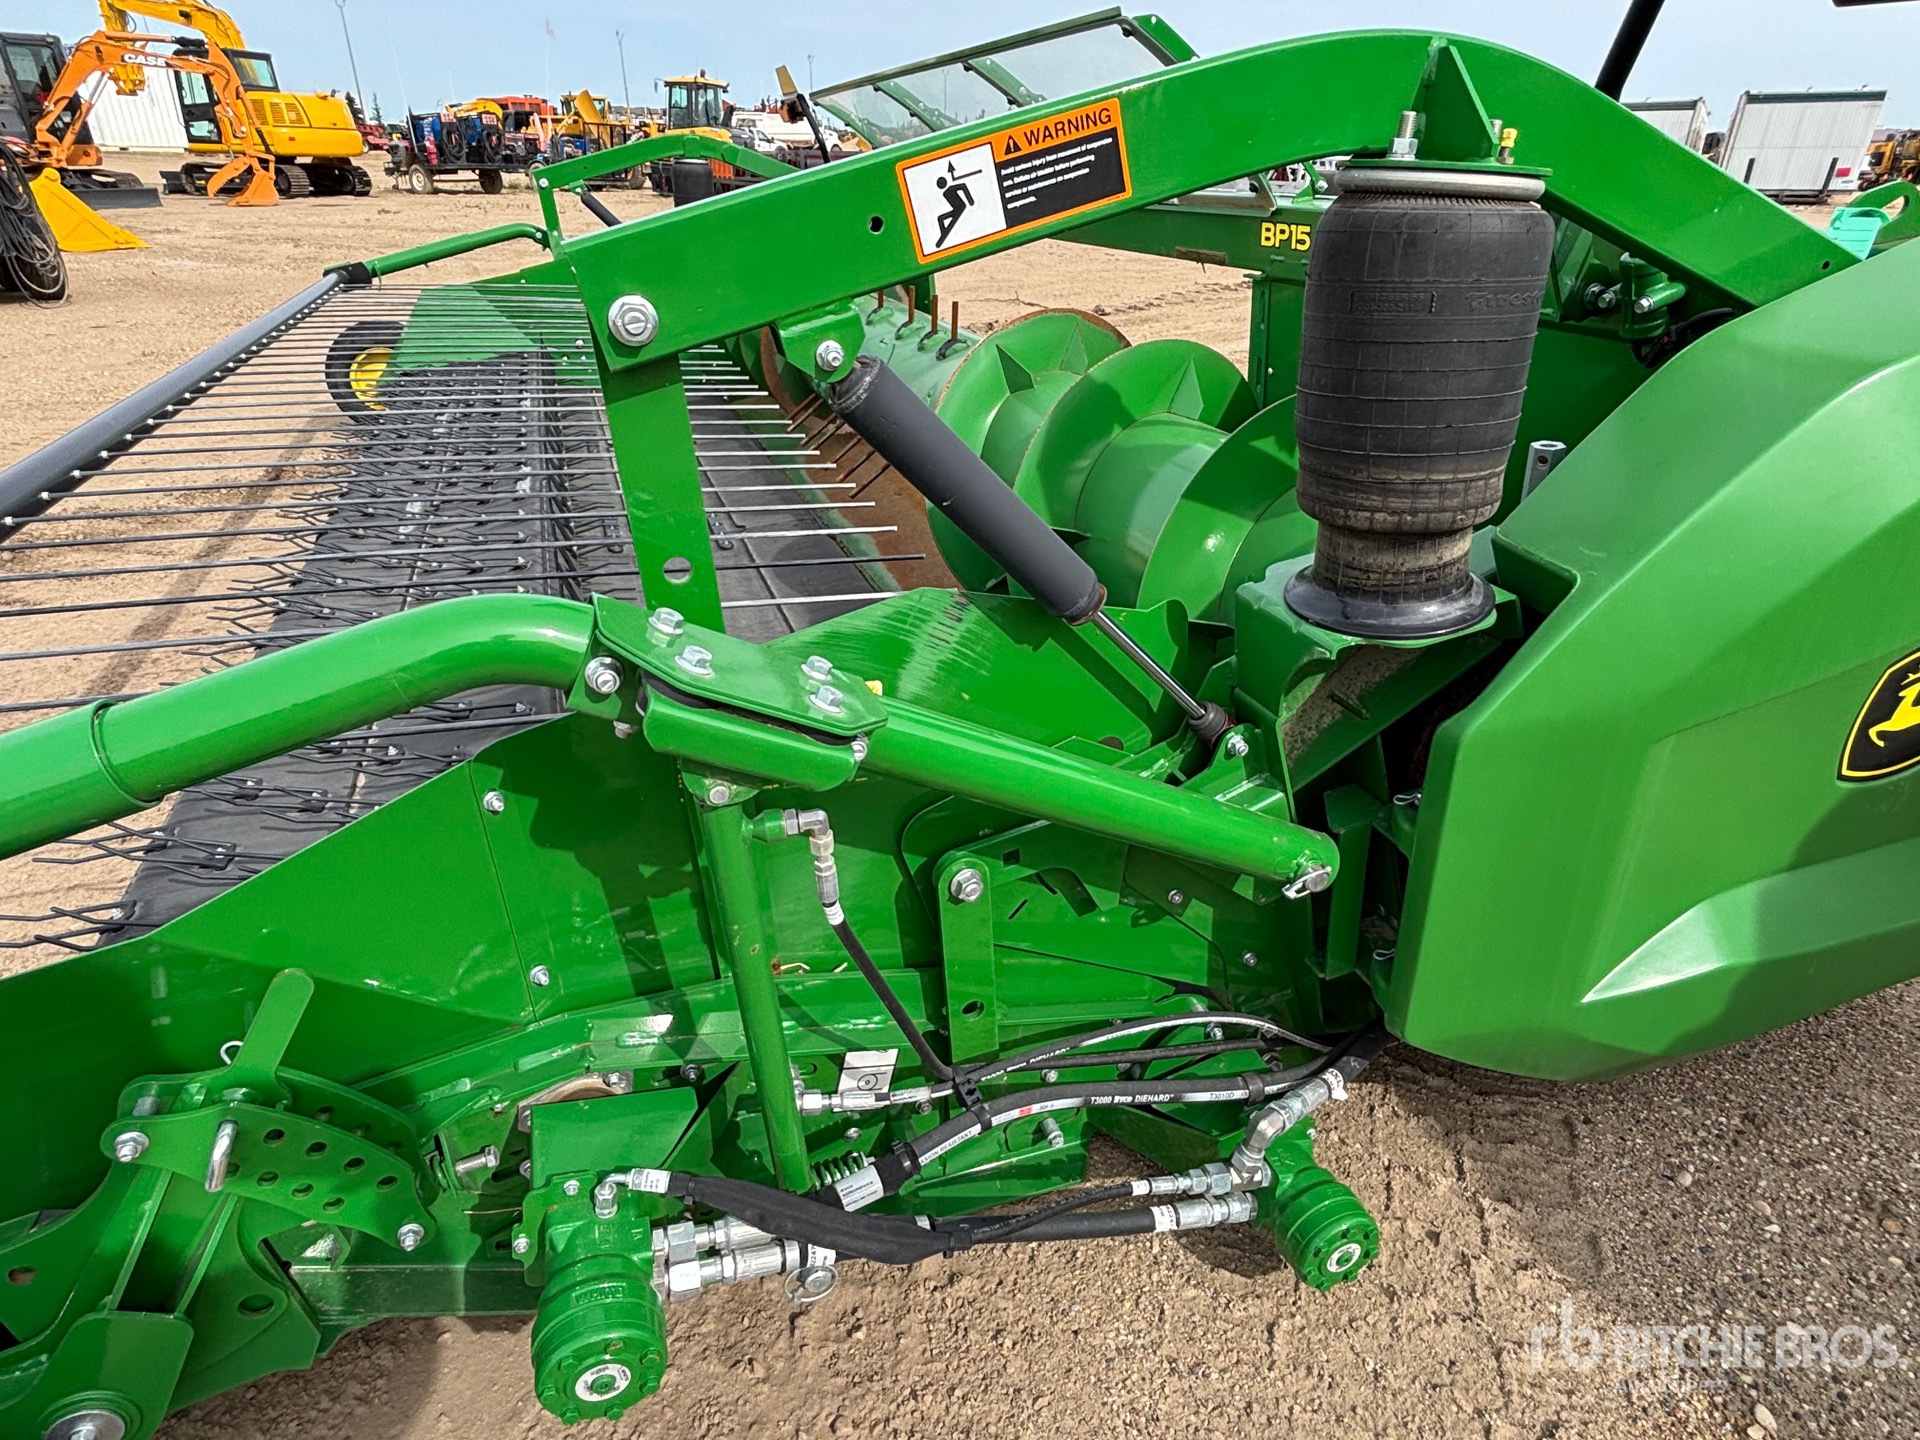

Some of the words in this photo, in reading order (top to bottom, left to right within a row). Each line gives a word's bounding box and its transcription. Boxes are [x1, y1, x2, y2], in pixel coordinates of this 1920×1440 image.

[123, 53, 167, 67] CASE
[1023, 107, 1113, 147] WARNING
[1260, 221, 1312, 252] BP15
[939, 1130, 973, 1153] RESISTANT
